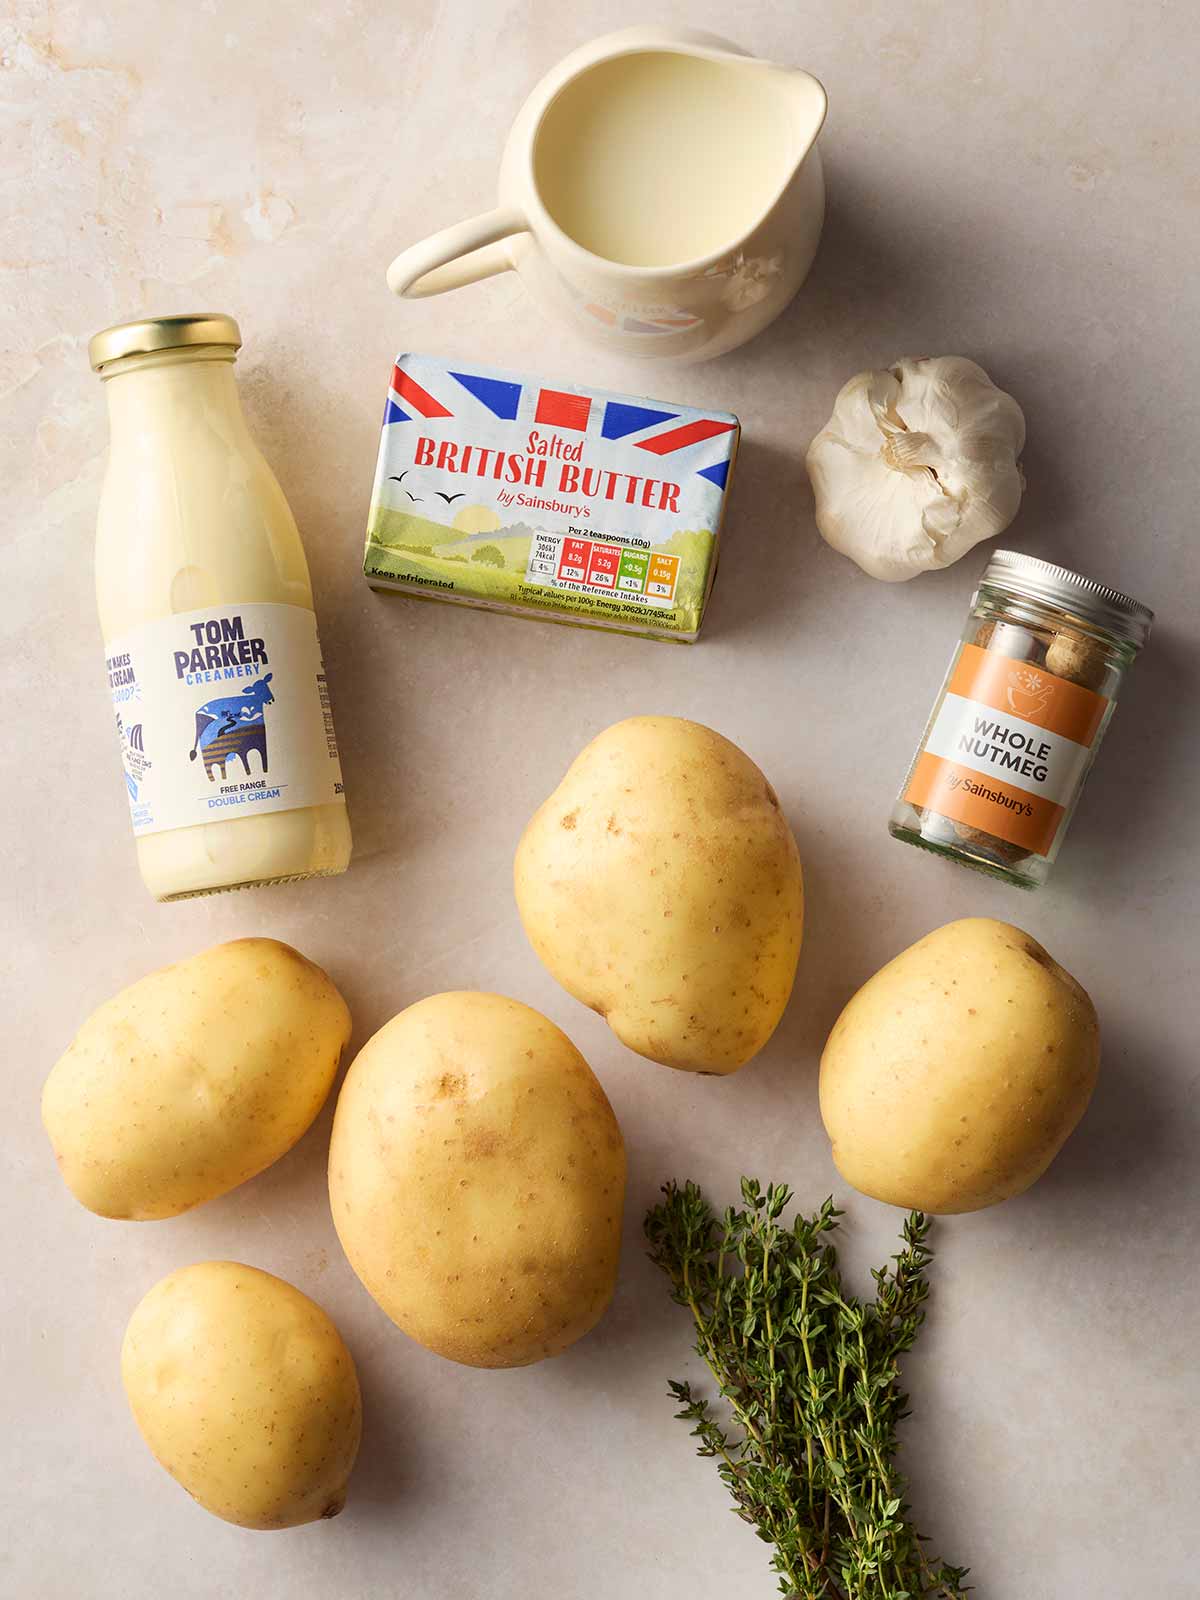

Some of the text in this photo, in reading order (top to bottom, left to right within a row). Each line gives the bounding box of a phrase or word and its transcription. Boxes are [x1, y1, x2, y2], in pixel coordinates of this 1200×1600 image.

[526, 430, 583, 462] Salted
[414, 437, 681, 513] BRITISH BUTTER
[497, 488, 591, 518] by Sainsbury's
[536, 534, 561, 545] ENERGY
[568, 526, 650, 549] Per 2 teaspoons (10g)
[571, 541, 584, 550] FAT
[535, 551, 555, 561] 74kcal
[537, 543, 555, 553] 306kJ
[593, 545, 621, 557] SATURATES
[624, 550, 648, 561] SUGARS
[538, 563, 549, 571] 4%
[567, 553, 582, 565] 8.2g
[597, 558, 612, 570] 5.2g
[656, 557, 673, 566] SALT
[371, 567, 454, 589] Keep refrigerated
[566, 568, 579, 577] 12%
[595, 573, 609, 583] 26%
[653, 569, 671, 580] 0.15g
[550, 578, 648, 604] % of the Reference Intakes
[656, 584, 666, 594] 3%
[518, 585, 543, 597] Typical
[543, 590, 565, 601] values
[565, 595, 578, 604] per
[596, 600, 621, 611] Energy
[622, 605, 677, 621] 3062kJ/745kcal
[190, 616, 245, 646] TOM
[174, 638, 268, 679] PARKER
[113, 667, 136, 688] CREAM
[185, 663, 262, 686] CREAMERY
[974, 716, 1051, 760] WHOLE
[959, 735, 1049, 782] NUTMEG
[220, 780, 266, 794] FREE RANGE
[208, 789, 281, 808] DOUBLE CREAM
[962, 778, 1033, 816] Sainsbury's
